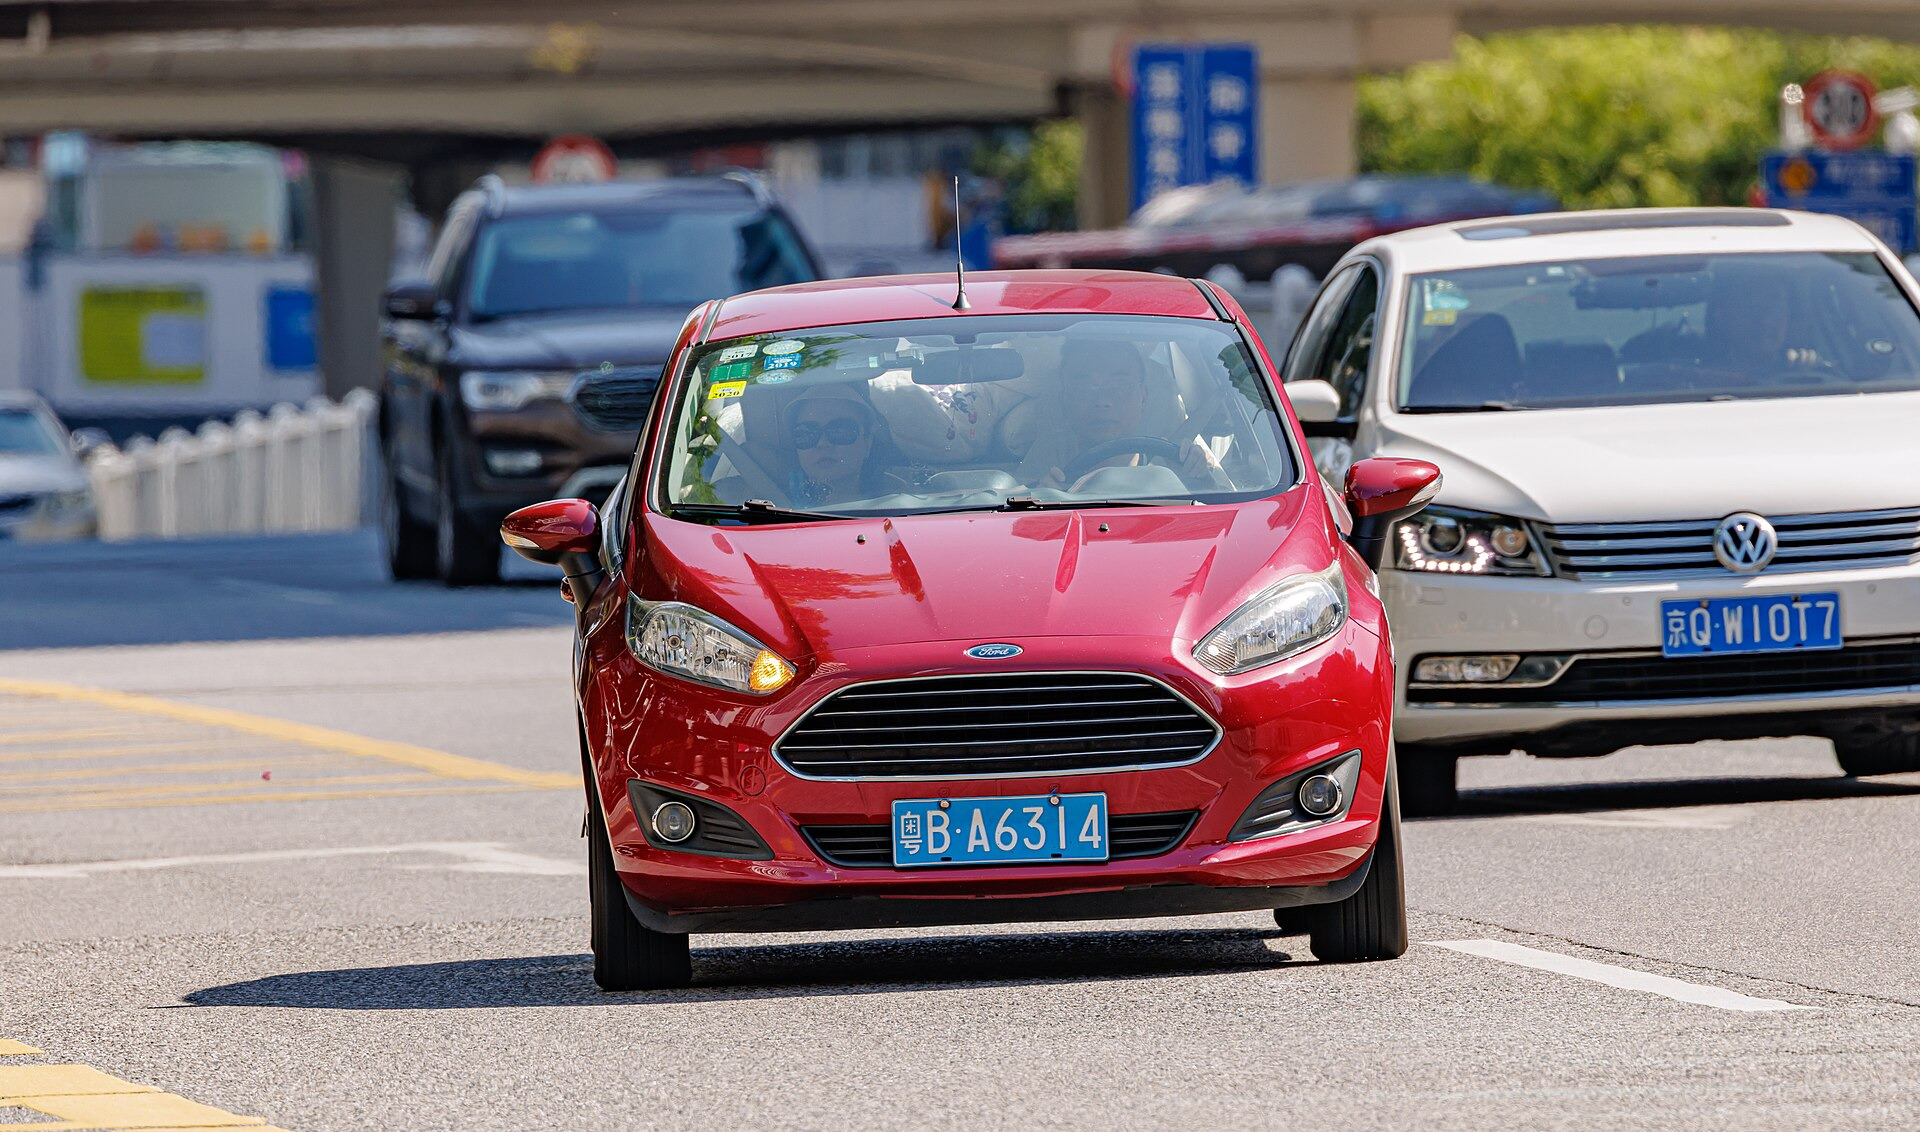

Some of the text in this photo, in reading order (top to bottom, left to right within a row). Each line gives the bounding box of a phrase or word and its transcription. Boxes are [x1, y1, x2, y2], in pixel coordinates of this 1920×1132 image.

[768, 361, 798, 369] 2019
[713, 390, 741, 399] 2020
[1719, 518, 1772, 566] VW
[978, 647, 1009, 656] Ford
